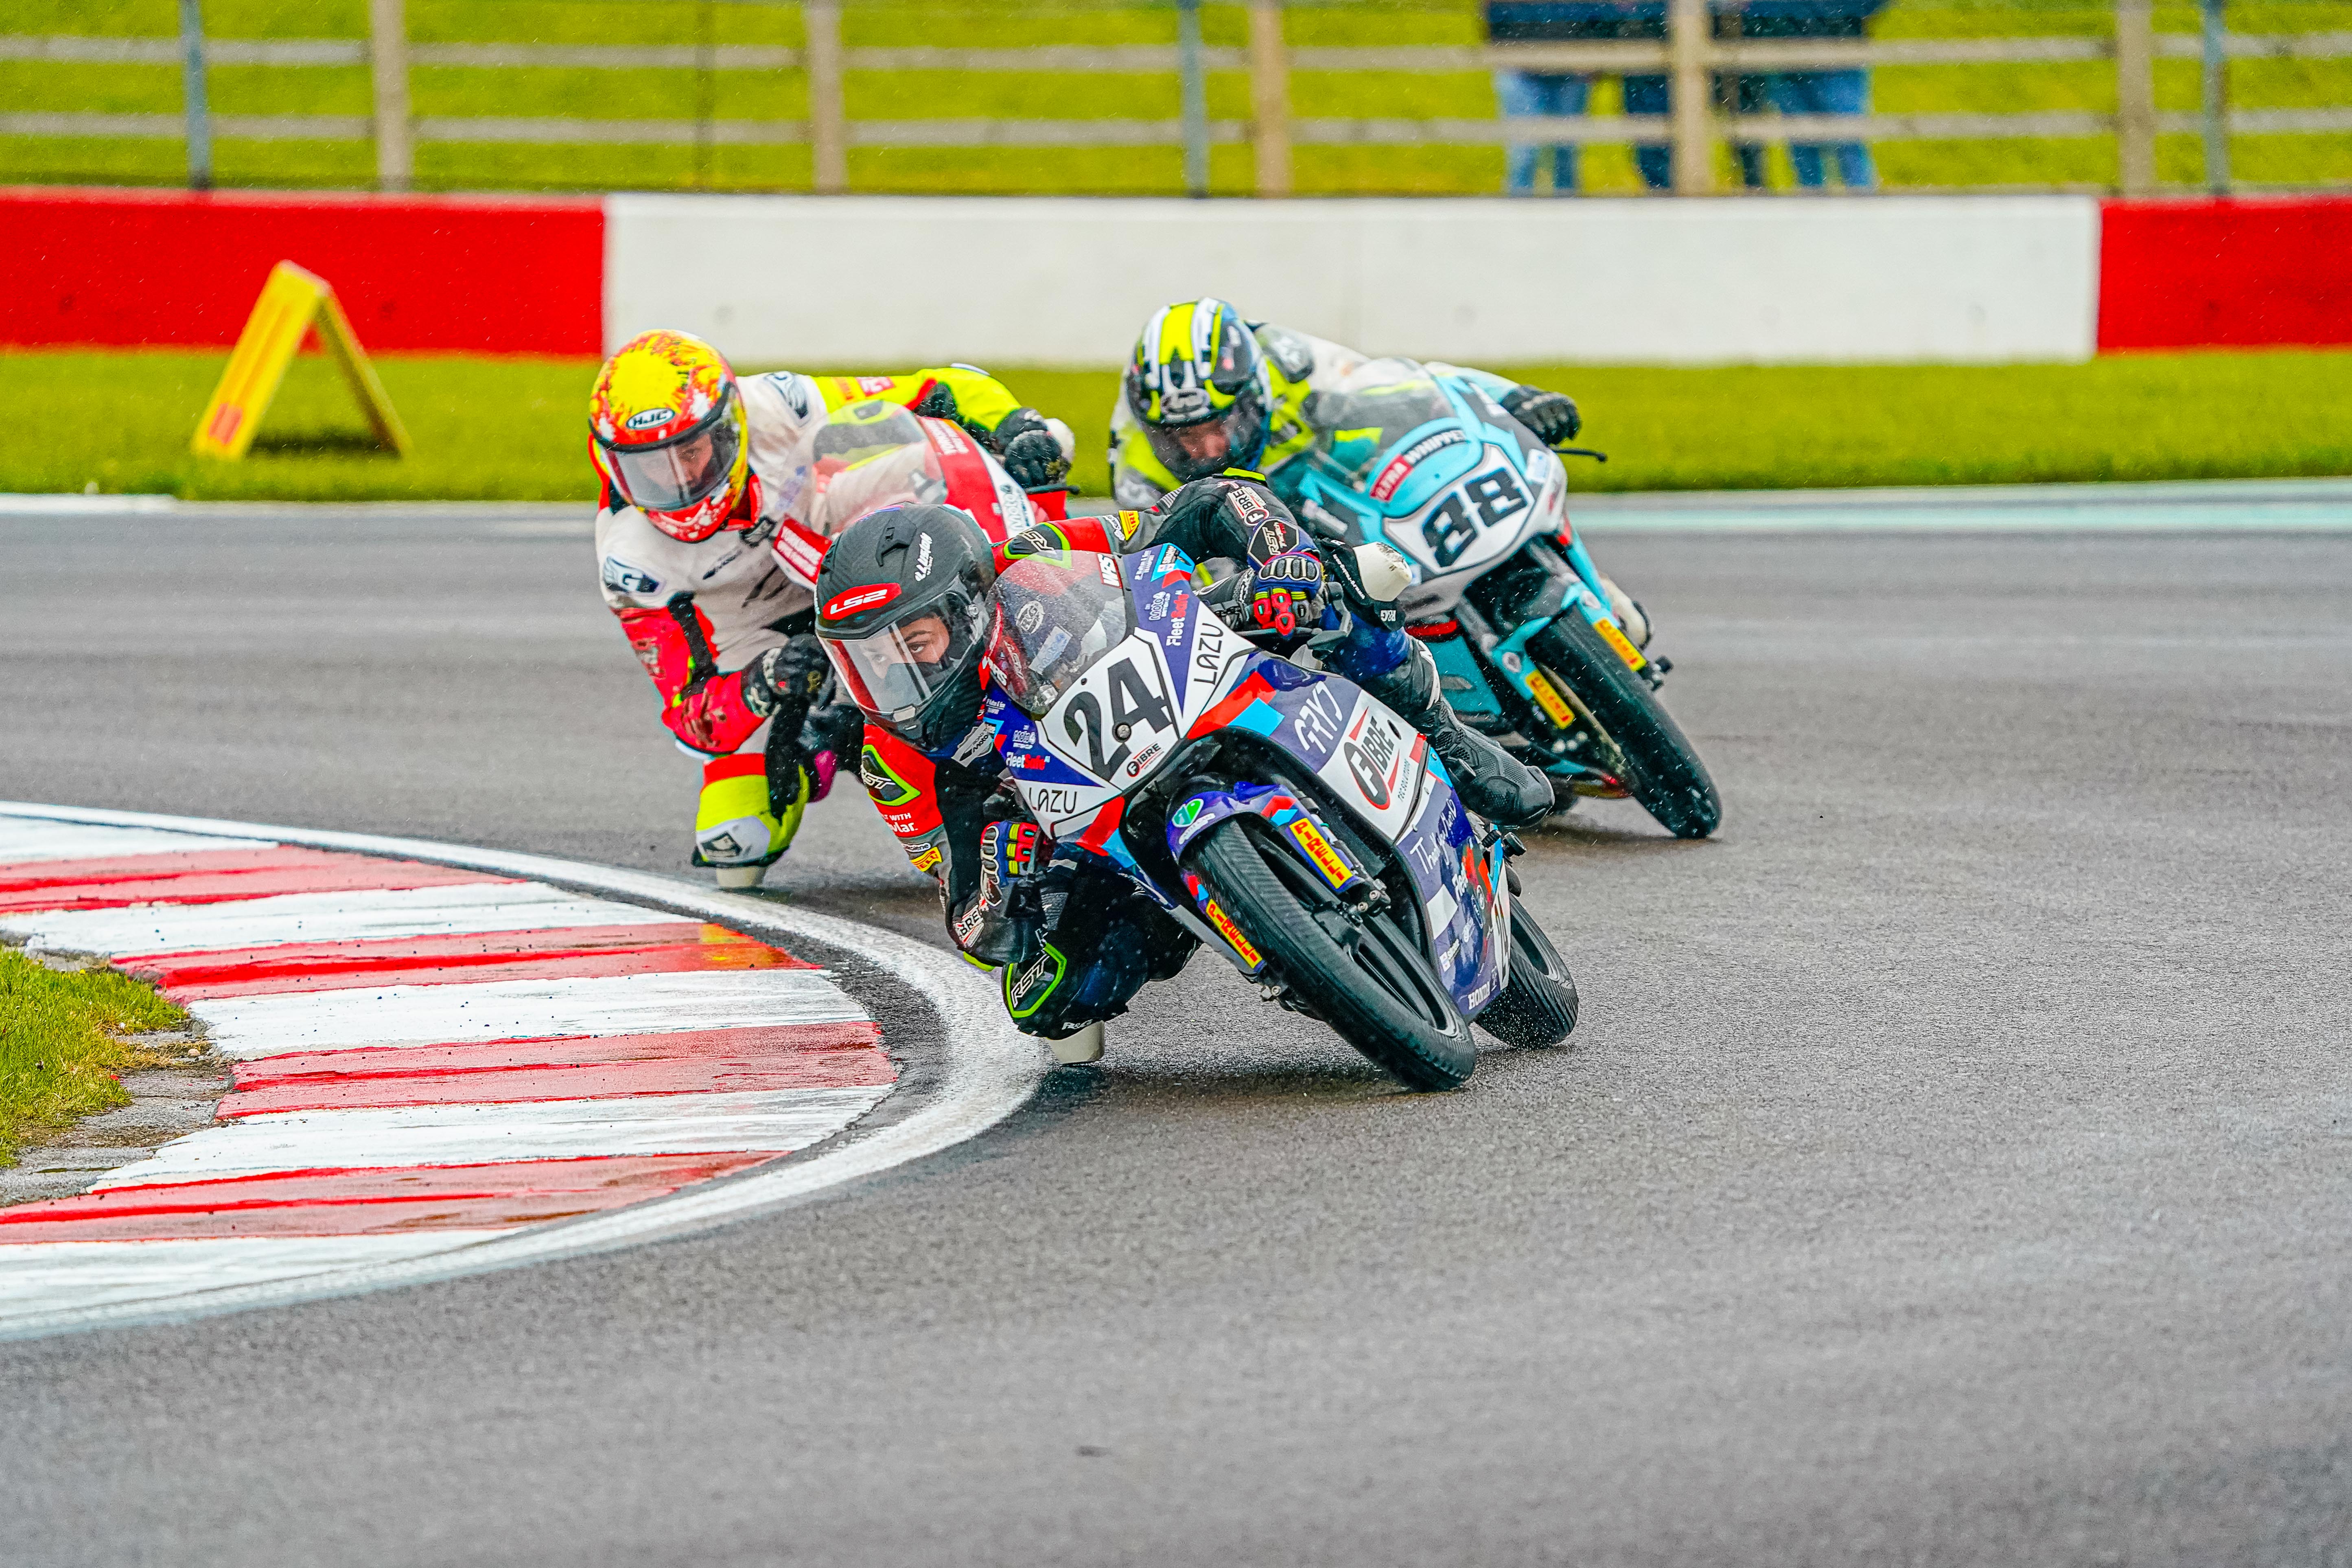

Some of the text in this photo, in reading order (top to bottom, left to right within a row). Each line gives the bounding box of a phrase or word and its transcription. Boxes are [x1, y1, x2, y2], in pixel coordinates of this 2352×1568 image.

[631, 410, 668, 426] HJC
[1233, 490, 1267, 524] FIBRE
[1422, 466, 1528, 568] 88
[1262, 527, 1281, 555] RST
[1333, 554, 1365, 599] www.rg-racing.com
[830, 589, 887, 614] LS2
[1149, 591, 1166, 621] Moto4
[1381, 610, 1396, 622] R&G
[1194, 623, 1223, 685] LAZU
[1063, 657, 1174, 781] 24
[973, 734, 991, 753] Moto
[1127, 743, 1162, 775] FIBRE
[1347, 716, 1394, 800] FIBRE
[1029, 787, 1077, 813] LAZU
[889, 813, 911, 821] WITH
[1293, 821, 1345, 881] PIRELLI
[1208, 903, 1258, 962] PIRELLI
[1011, 954, 1050, 1008] RST
[1061, 1019, 1094, 1030] R&G
